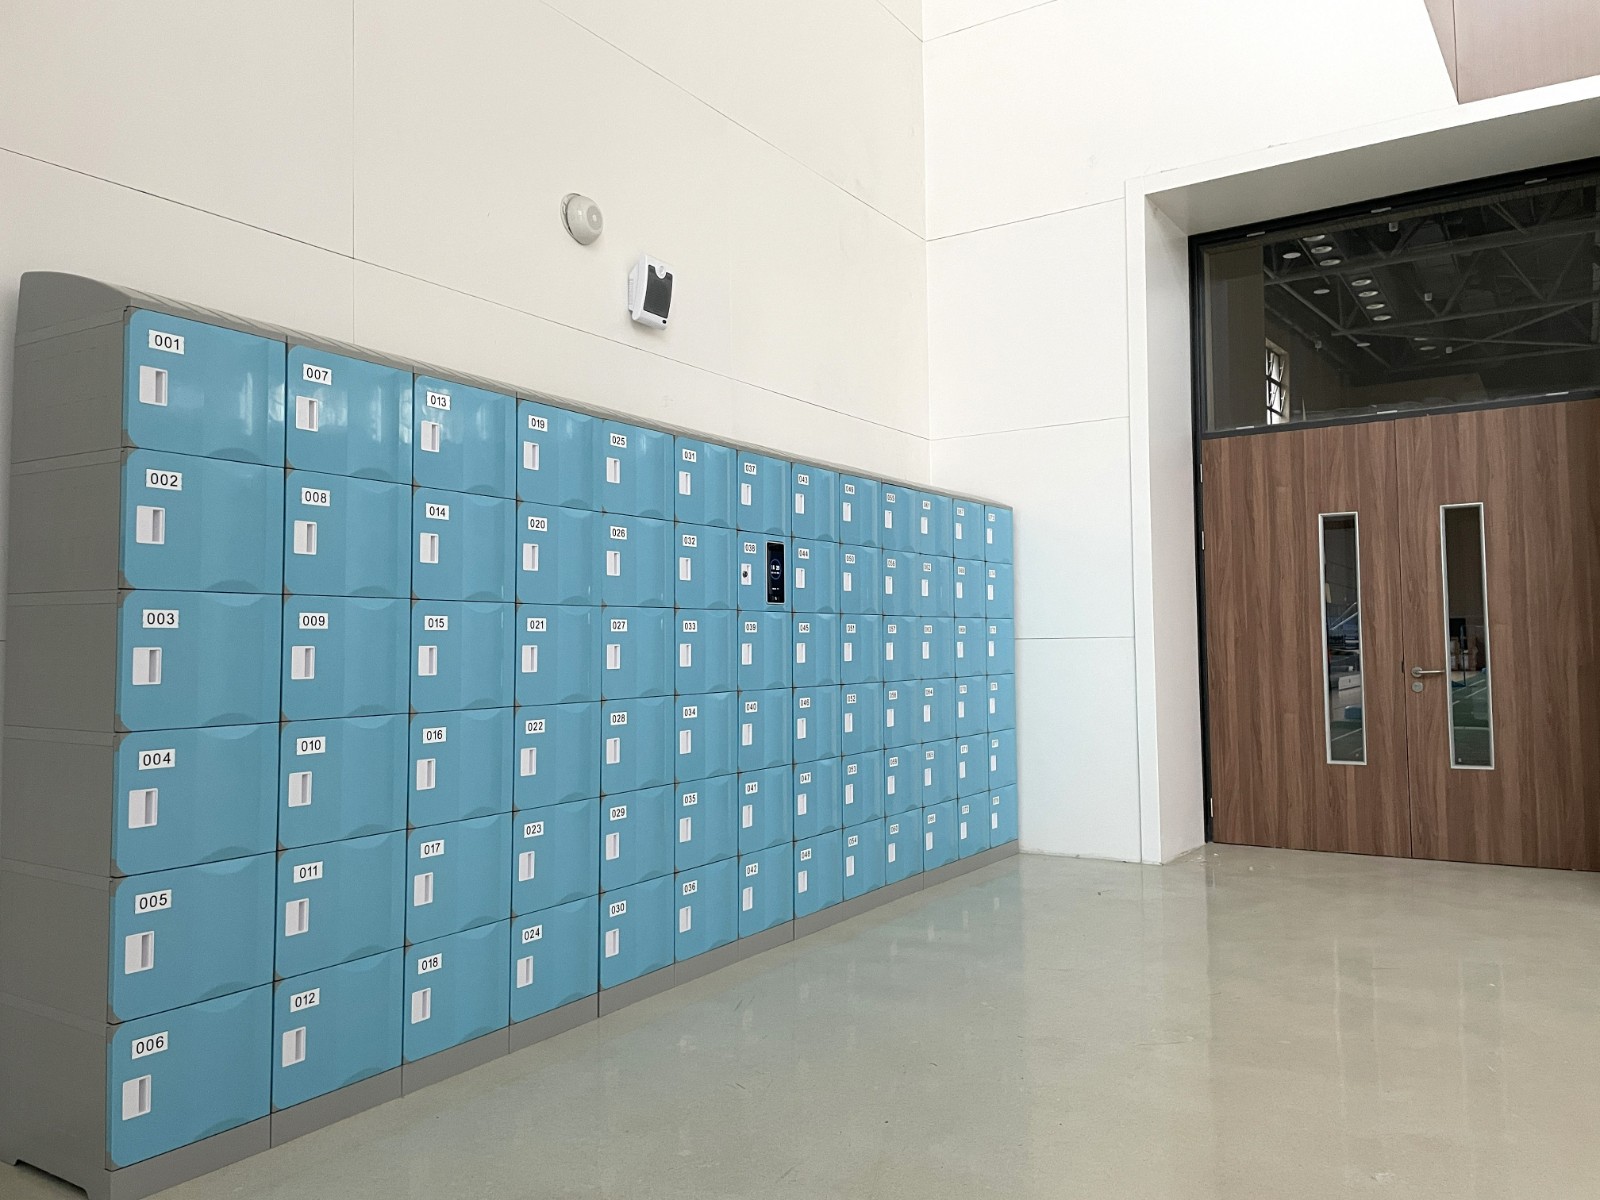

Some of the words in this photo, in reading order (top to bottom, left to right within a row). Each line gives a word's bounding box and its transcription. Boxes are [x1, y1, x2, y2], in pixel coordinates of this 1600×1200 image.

[154, 334, 180, 351] 001
[306, 367, 329, 381] 007
[430, 395, 447, 408] 013
[531, 417, 545, 429] 019
[612, 435, 626, 446] 025
[684, 450, 695, 460] 031
[745, 464, 756, 473] 037
[150, 472, 178, 488] 002
[304, 490, 327, 504] 008
[429, 505, 446, 517] 014
[529, 518, 546, 529] 020
[612, 528, 626, 538] 026
[683, 536, 696, 546] 032
[744, 543, 756, 553] 038
[147, 612, 175, 625] 003
[302, 615, 326, 627] 009
[427, 617, 445, 629] 015
[529, 619, 544, 630] 021
[612, 620, 626, 630] 027
[684, 622, 696, 631] 033
[745, 623, 757, 631] 039
[684, 708, 696, 717] 034
[746, 702, 757, 711] 040
[612, 713, 626, 724] 028
[527, 721, 544, 732] 022
[426, 729, 443, 741] 016
[301, 739, 322, 752] 010
[142, 751, 172, 767] 004
[747, 783, 757, 793] 041
[684, 794, 696, 804] 035
[611, 807, 626, 819] 029
[526, 823, 542, 836] 023
[424, 842, 441, 856] 017
[299, 864, 318, 879] 011
[746, 864, 757, 875] 042
[684, 882, 696, 893] 036
[139, 893, 168, 910] 005
[611, 902, 625, 915] 030
[524, 927, 540, 941] 024
[421, 956, 439, 971] 018
[294, 992, 316, 1008] 012
[136, 1035, 164, 1055] 006
